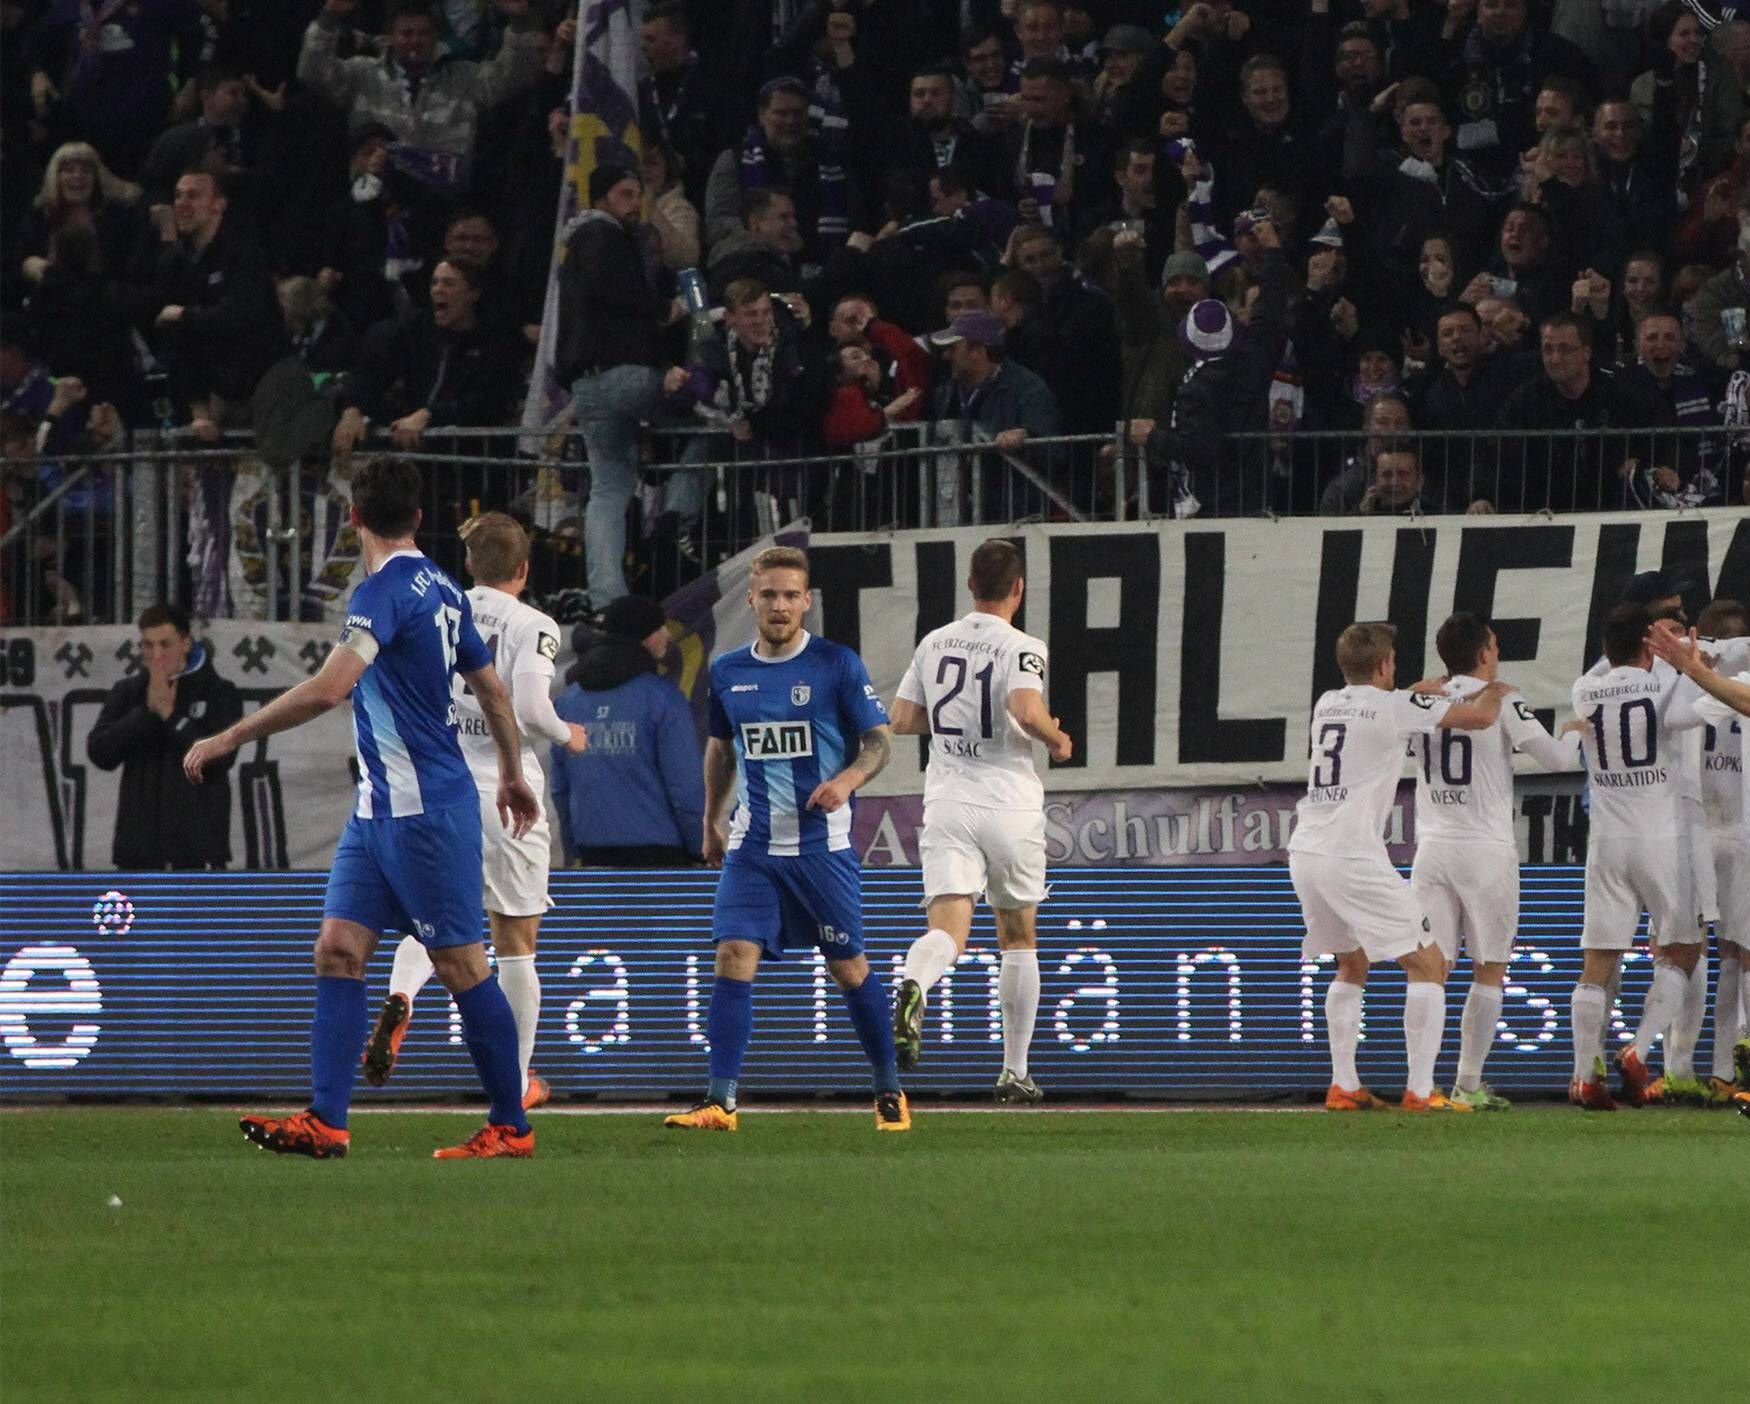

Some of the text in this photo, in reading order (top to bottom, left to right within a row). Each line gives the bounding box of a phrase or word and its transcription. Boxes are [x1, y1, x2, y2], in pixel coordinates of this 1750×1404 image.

[932, 655, 994, 739] 21
[745, 725, 808, 757] FAM
[1312, 723, 1347, 788] 3
[1587, 697, 1658, 770] 10
